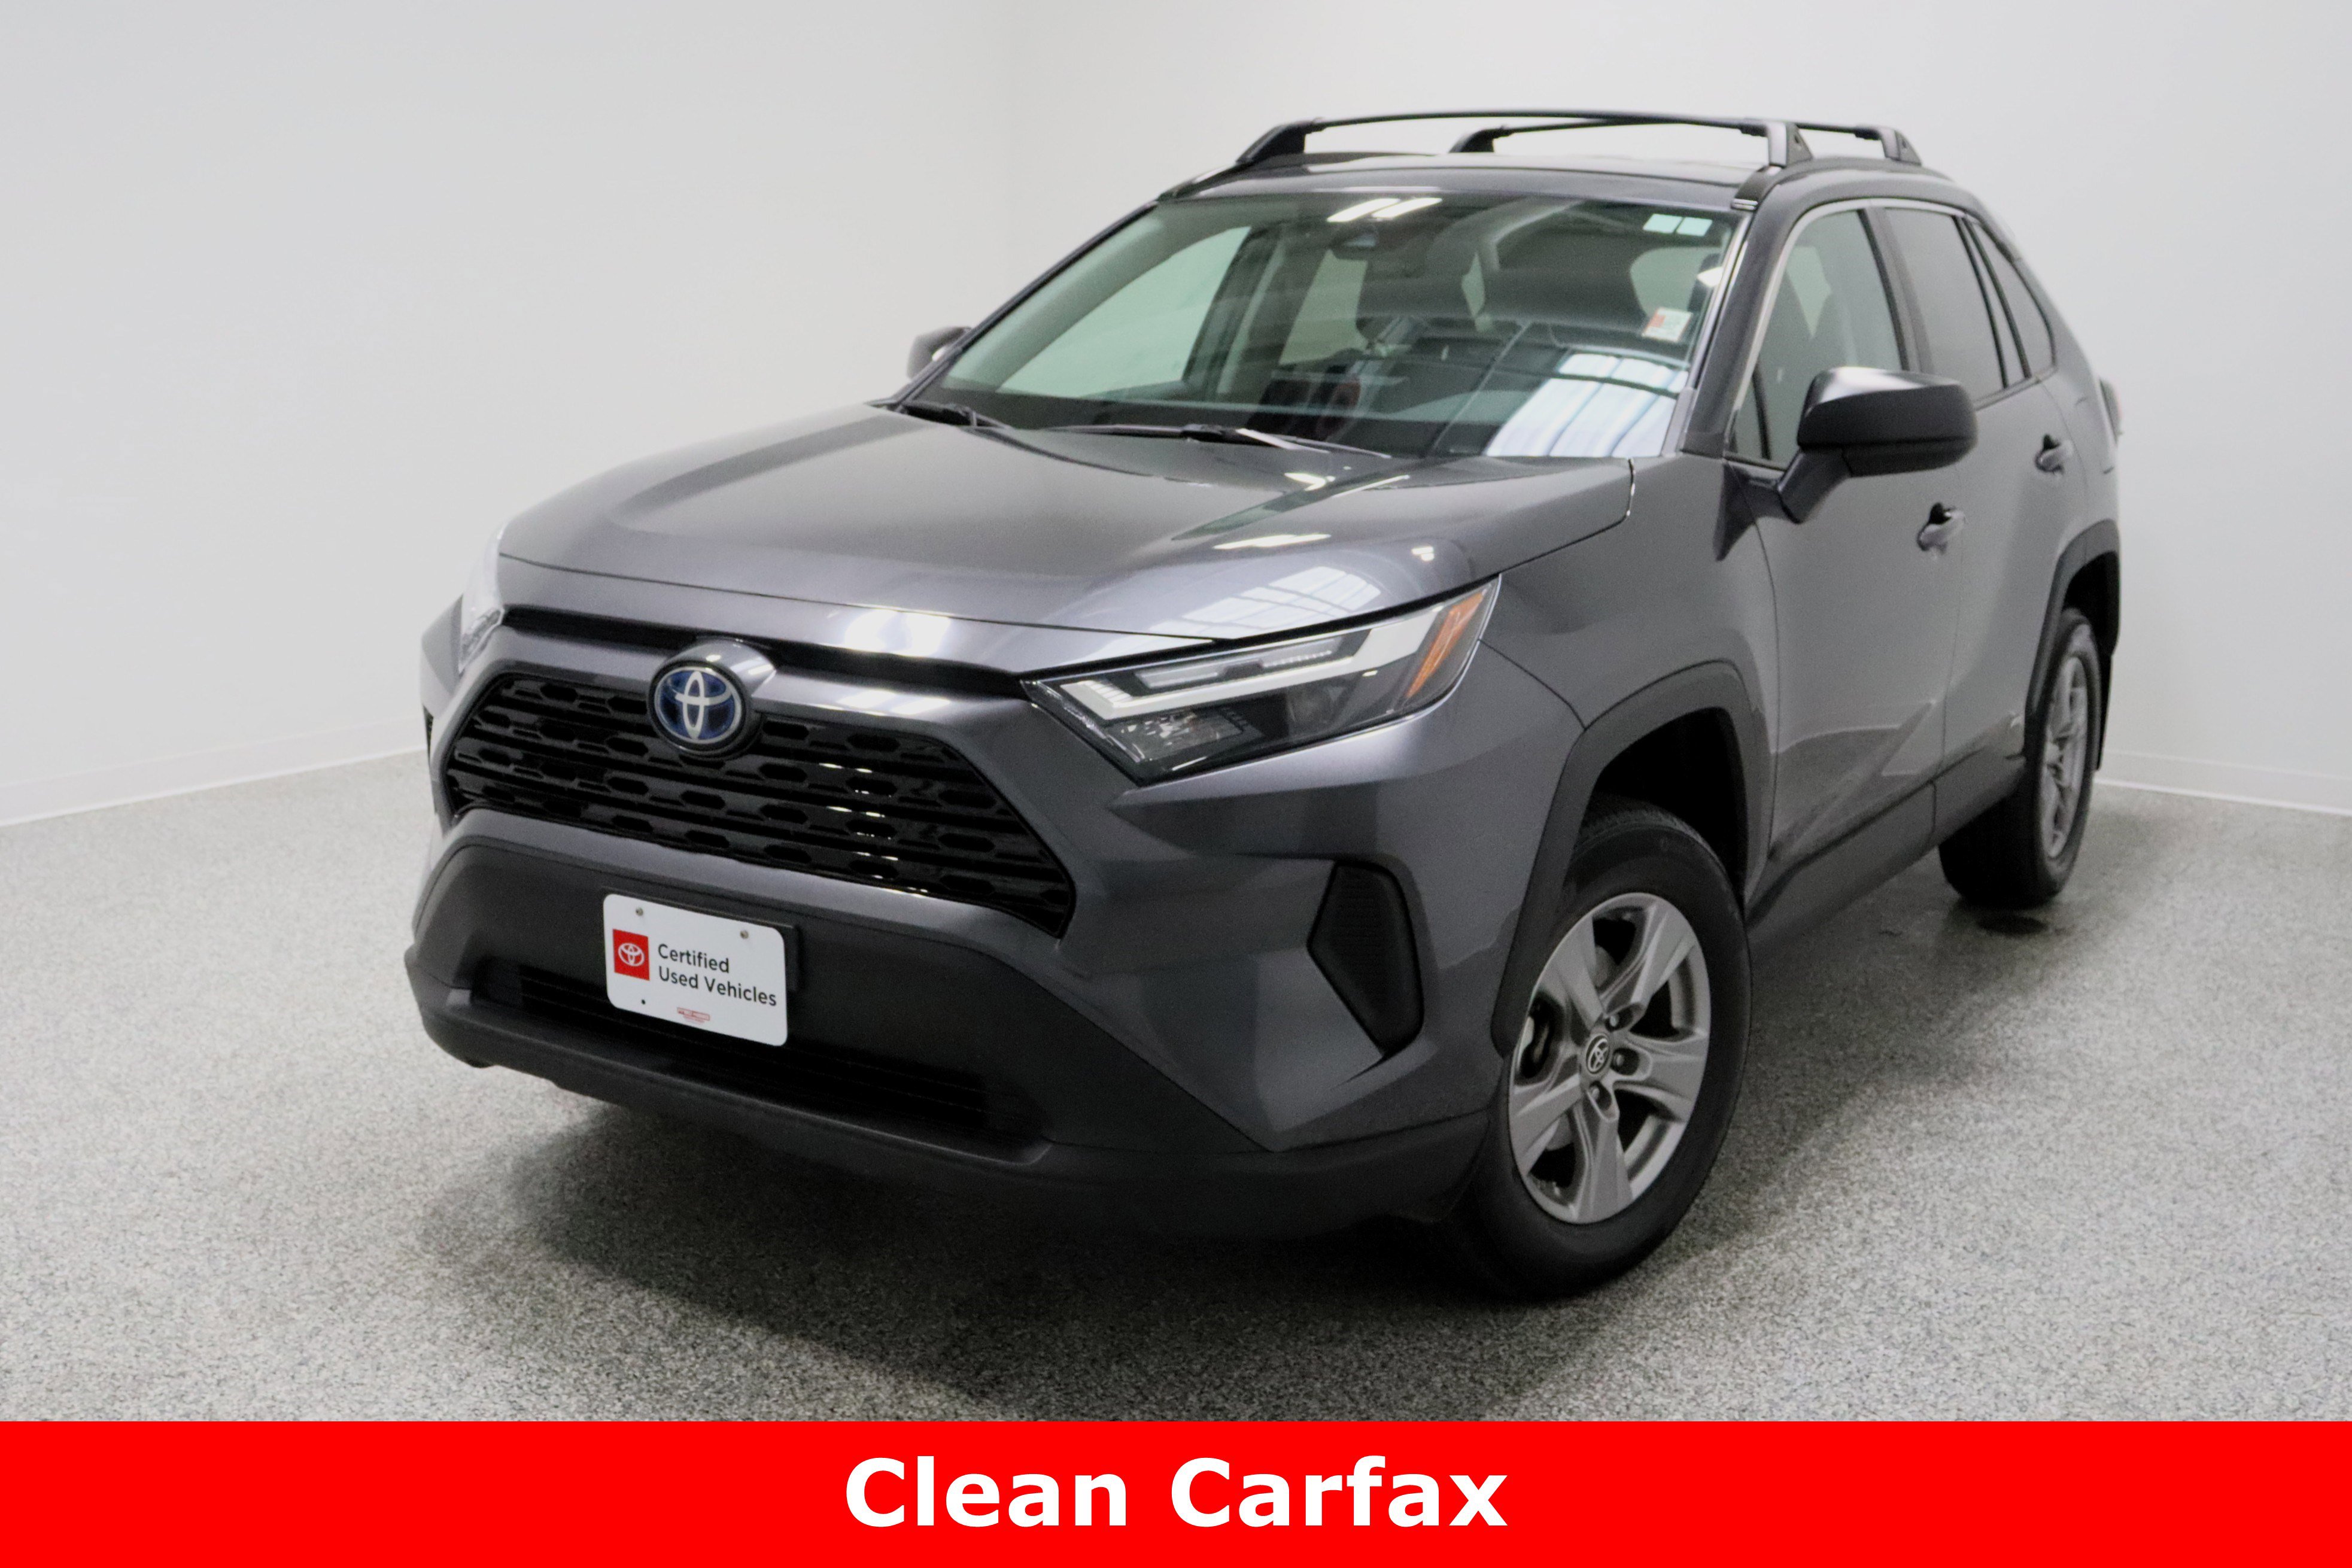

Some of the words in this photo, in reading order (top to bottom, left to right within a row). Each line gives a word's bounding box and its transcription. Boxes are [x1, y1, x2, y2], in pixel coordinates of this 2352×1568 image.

[658, 943, 730, 974] Certified
[658, 965, 699, 989] Used
[704, 976, 777, 1007] Vehicles
